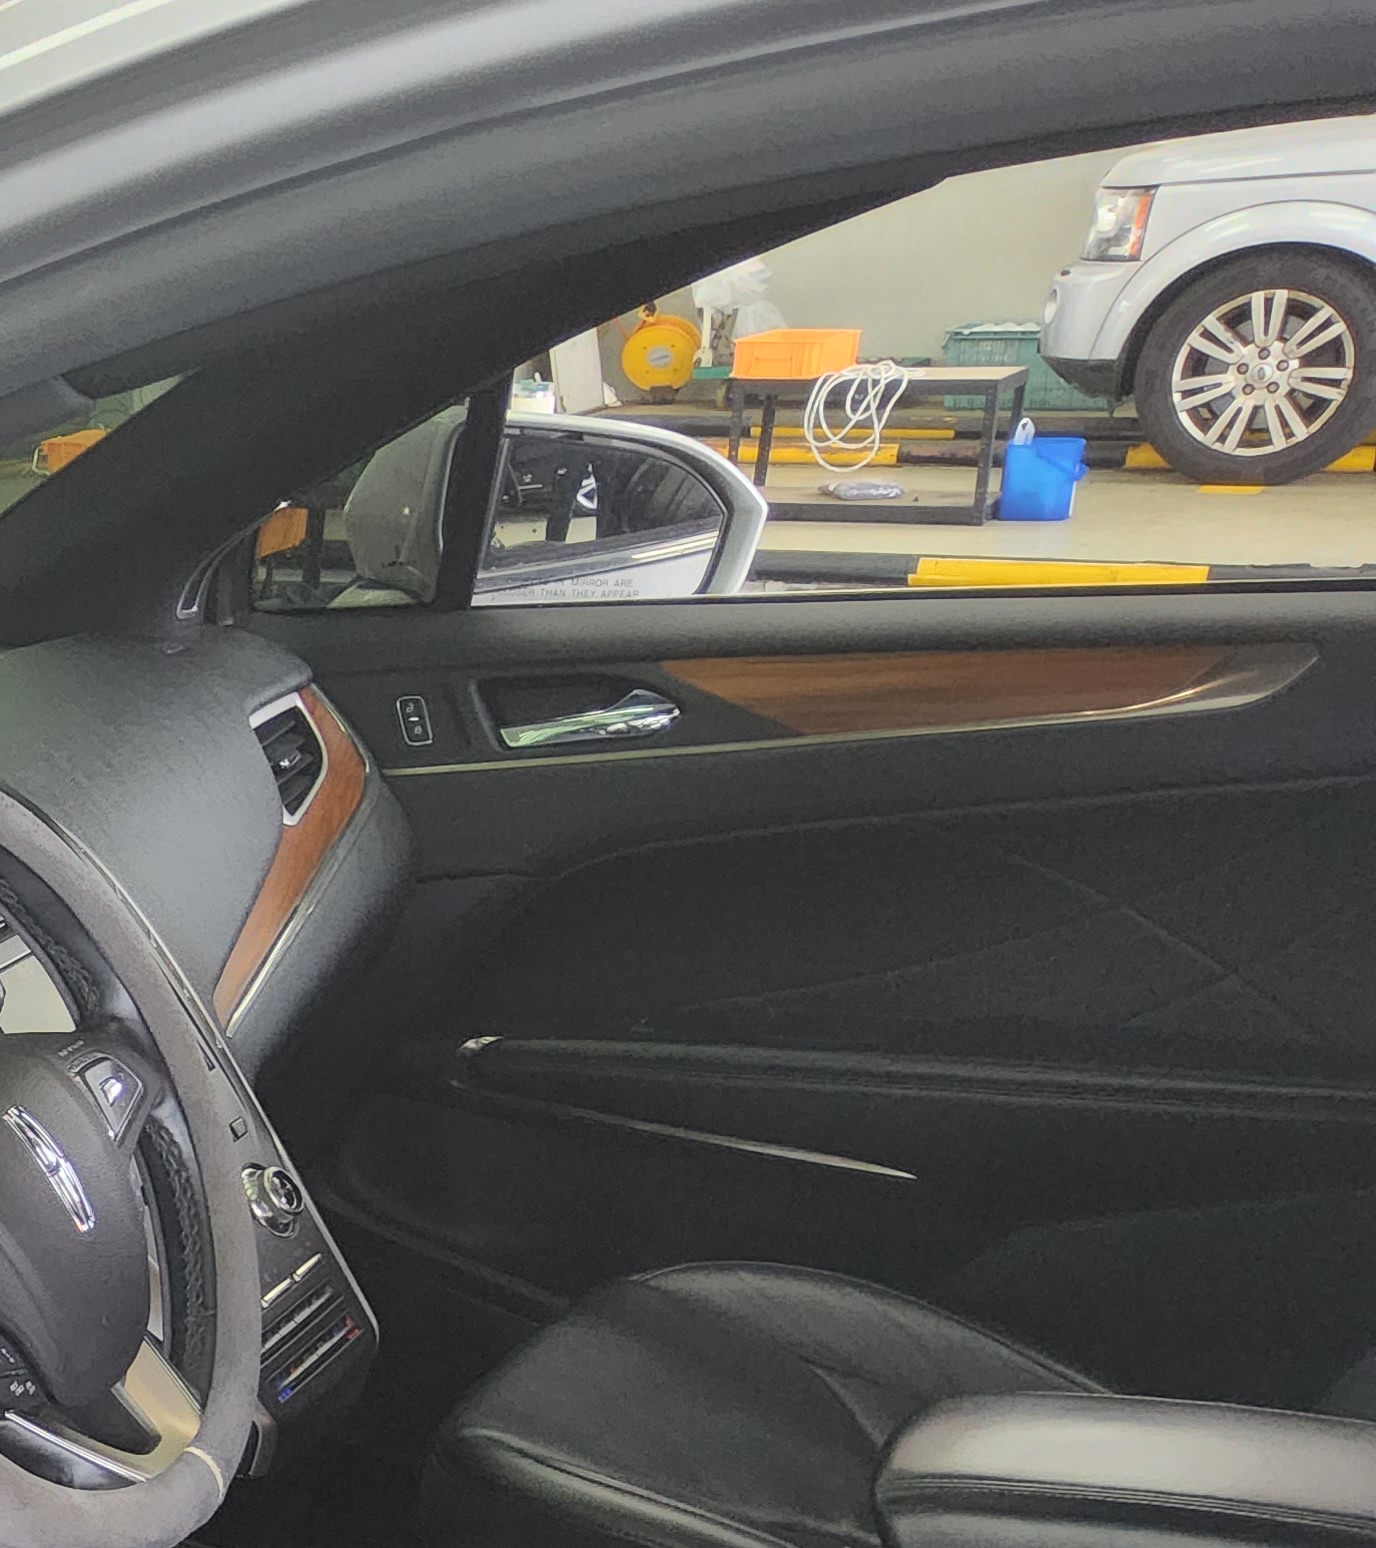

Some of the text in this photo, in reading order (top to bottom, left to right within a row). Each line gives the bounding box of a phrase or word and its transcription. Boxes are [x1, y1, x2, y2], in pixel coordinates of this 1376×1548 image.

[614, 579, 633, 587] ARE
[572, 589, 596, 598] THEY
[600, 589, 640, 598] APPEAR
